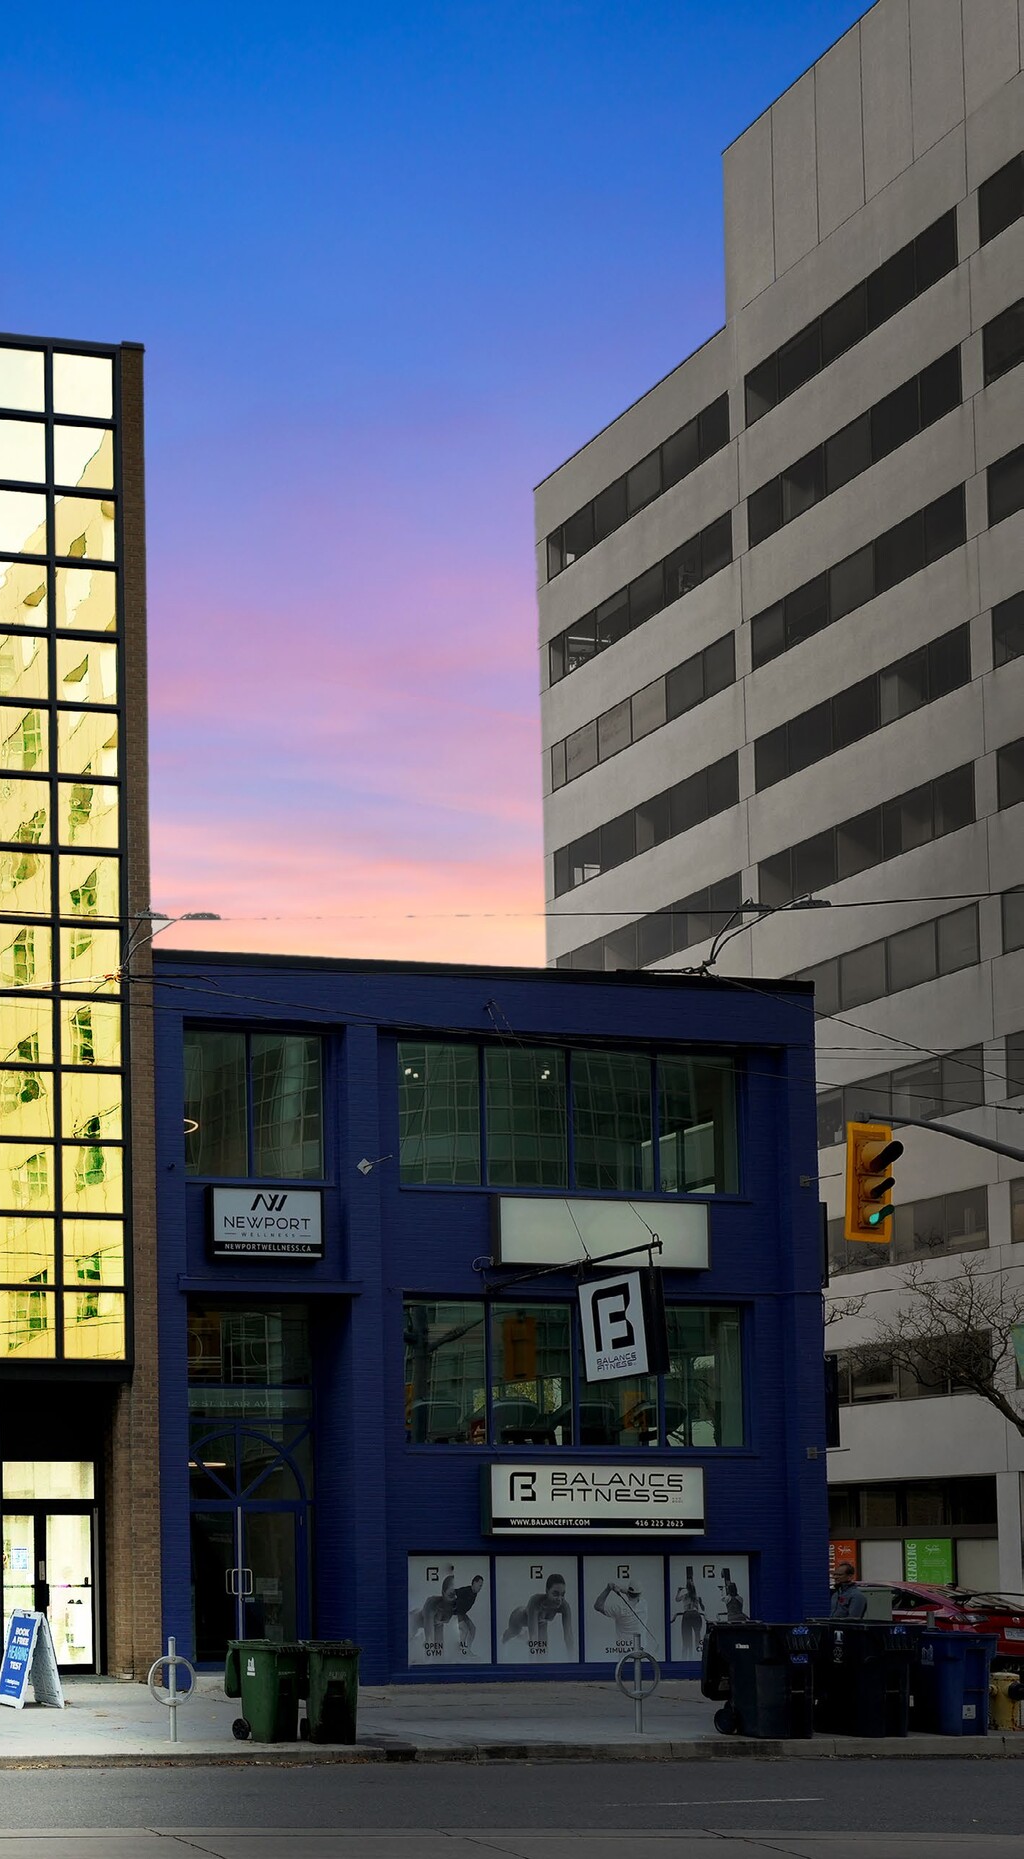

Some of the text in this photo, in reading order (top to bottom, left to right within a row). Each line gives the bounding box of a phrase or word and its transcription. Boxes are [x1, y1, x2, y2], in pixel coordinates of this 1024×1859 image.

[224, 1216, 311, 1229] NEWPORT
[224, 1243, 312, 1252] NEWPORTWELLNESS.CA
[596, 1351, 637, 1366] BALANCE
[551, 1472, 683, 1491] BALANCE
[551, 1488, 669, 1502] FITNESS
[509, 1518, 591, 1526] WWW.BALANCEFIT.COM
[635, 1519, 649, 1527] 416
[651, 1519, 664, 1527] 225
[907, 1543, 917, 1582] READING
[15, 1627, 30, 1637] BOOK
[11, 1636, 17, 1644] A
[528, 1640, 547, 1648] OPEN
[424, 1642, 443, 1650] OPEN
[10, 1661, 22, 1670] TEST
